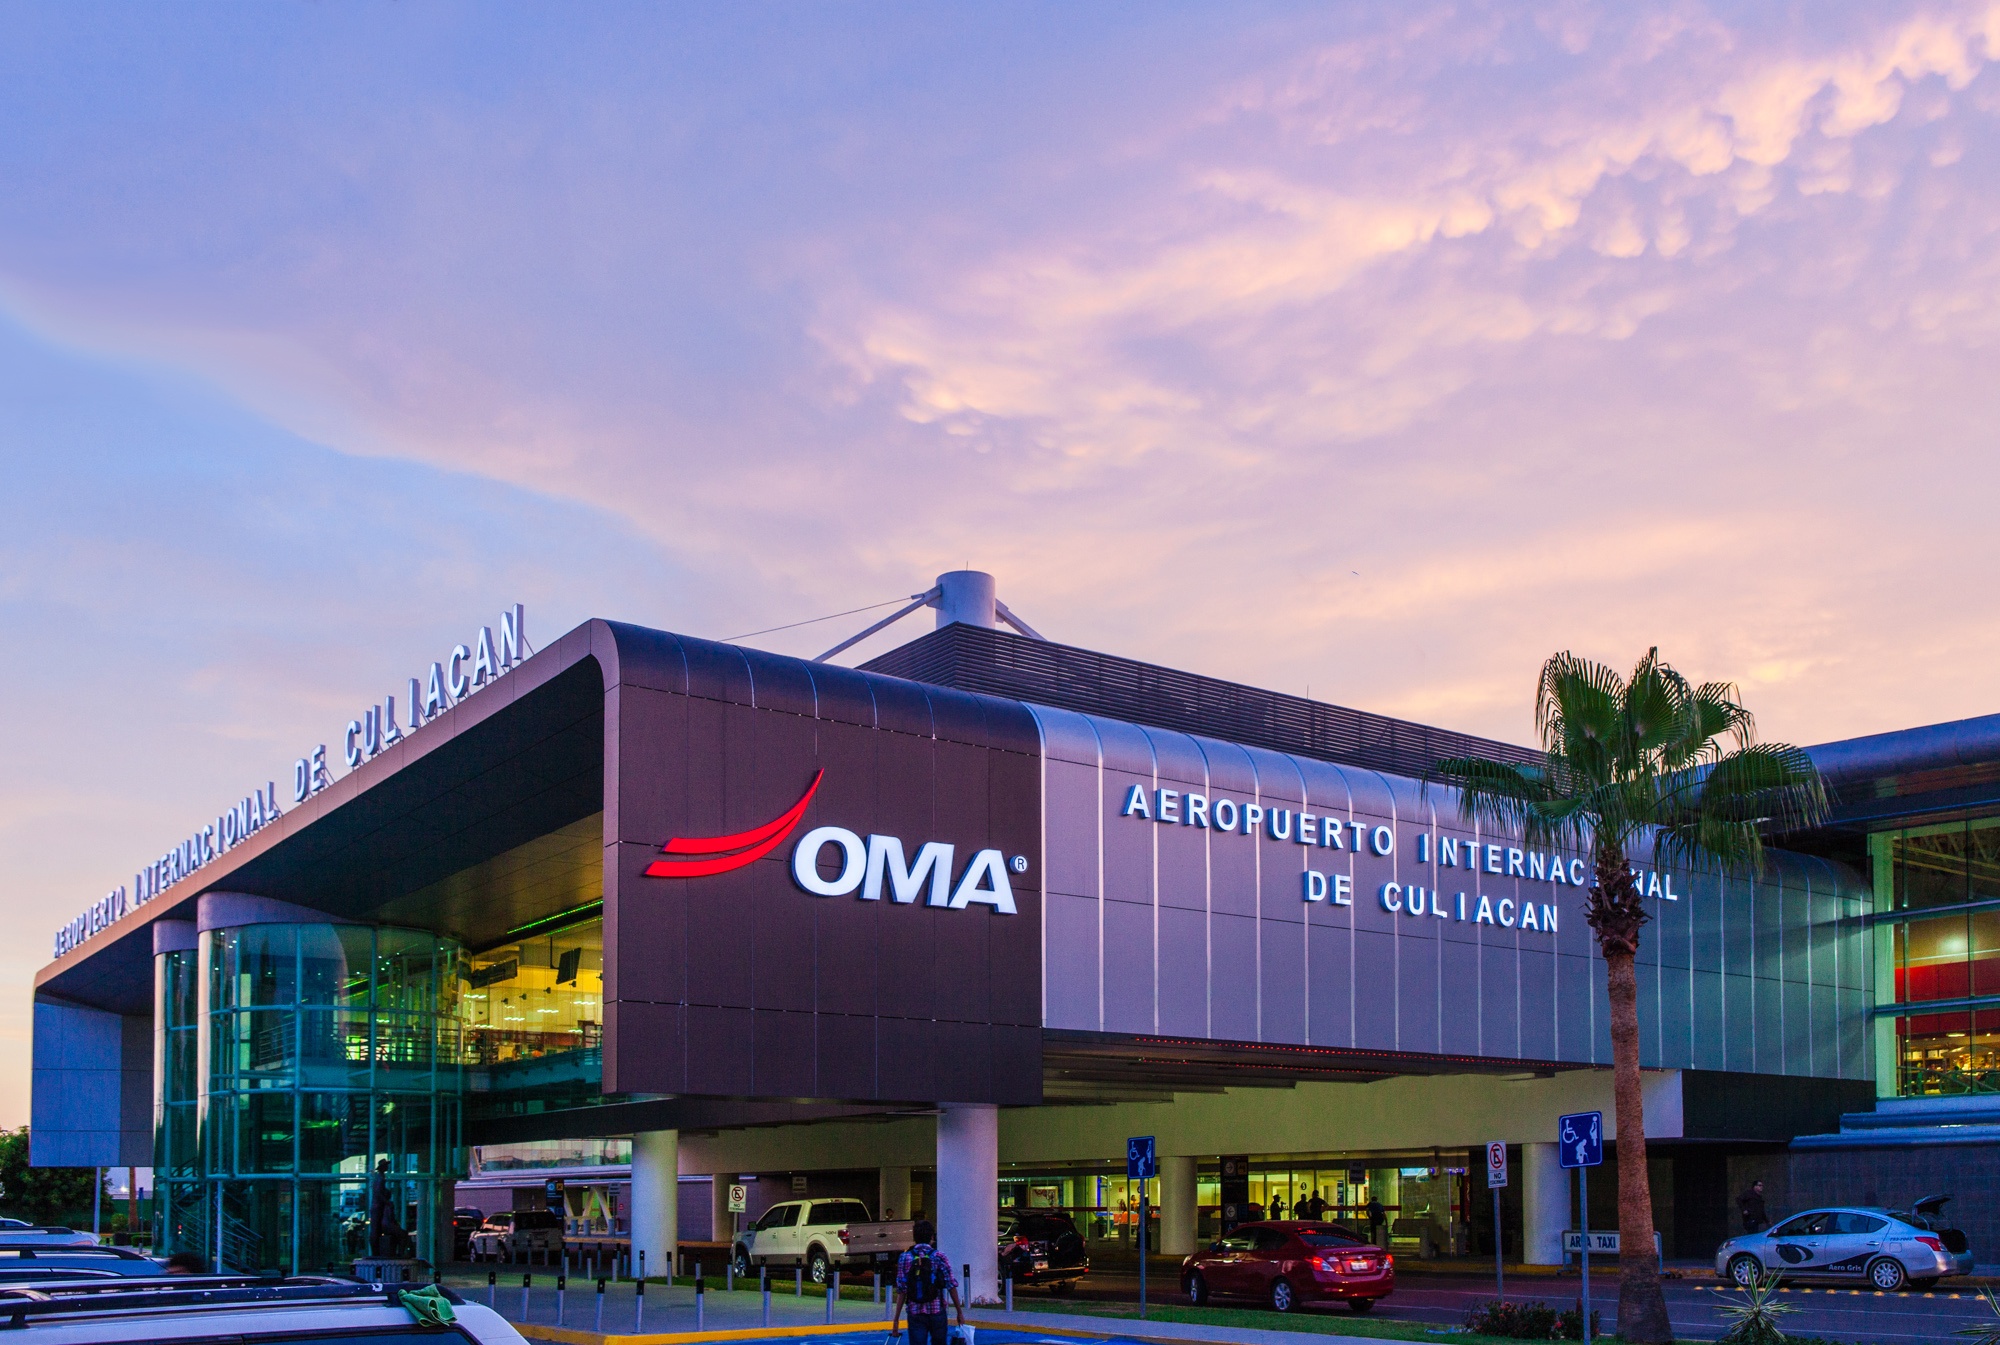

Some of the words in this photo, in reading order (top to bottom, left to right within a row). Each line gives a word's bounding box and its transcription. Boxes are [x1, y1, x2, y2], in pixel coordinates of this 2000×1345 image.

[53, 885, 126, 959] AEROPUERTO
[134, 781, 279, 906] INTERNACIONAL
[294, 743, 326, 803] DE
[344, 602, 524, 768] CULIACAN
[791, 826, 1018, 915] OMA
[1123, 784, 1394, 857] AEROPUERTO
[1418, 832, 1679, 902] INTERNACNAL
[1303, 870, 1351, 906] DE
[1379, 881, 1558, 933] CULIACAN
[1569, 1235, 1592, 1248] ARA
[1597, 1236, 1616, 1249] TAXI
[1847, 1264, 1862, 1272] Gris
